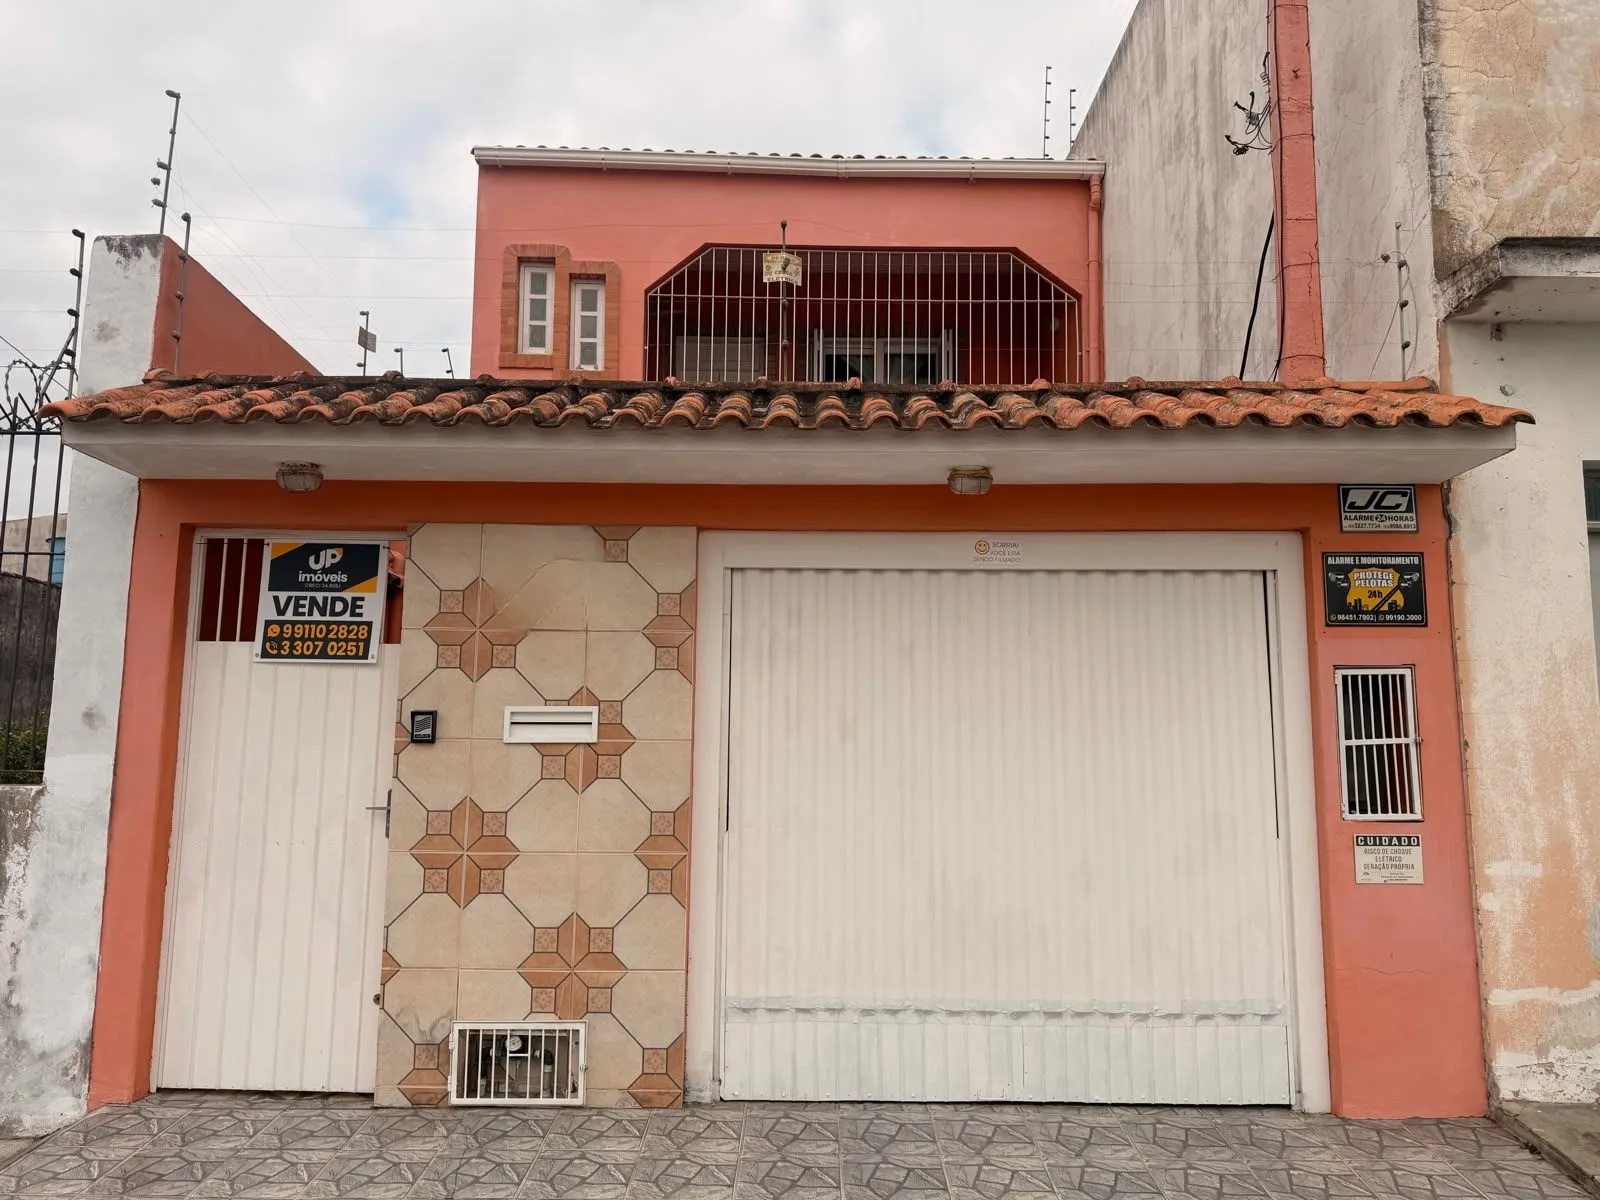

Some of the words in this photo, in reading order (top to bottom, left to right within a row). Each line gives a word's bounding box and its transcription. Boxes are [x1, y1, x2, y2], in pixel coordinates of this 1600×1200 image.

[1347, 491, 1409, 510] JC
[1343, 514, 1375, 522] ALARME
[308, 547, 343, 570] UP
[1327, 556, 1354, 565] ALARME
[1355, 556, 1360, 565] E
[1361, 556, 1419, 565] MONITORAMENTO
[298, 570, 348, 583] imóveis
[1354, 571, 1394, 580] PROTEGE
[1355, 579, 1394, 587] PELOTAS
[272, 595, 365, 617] VENDE
[328, 624, 368, 639] 2828
[327, 642, 364, 656] 0251
[1357, 836, 1418, 845] CUIDADO
